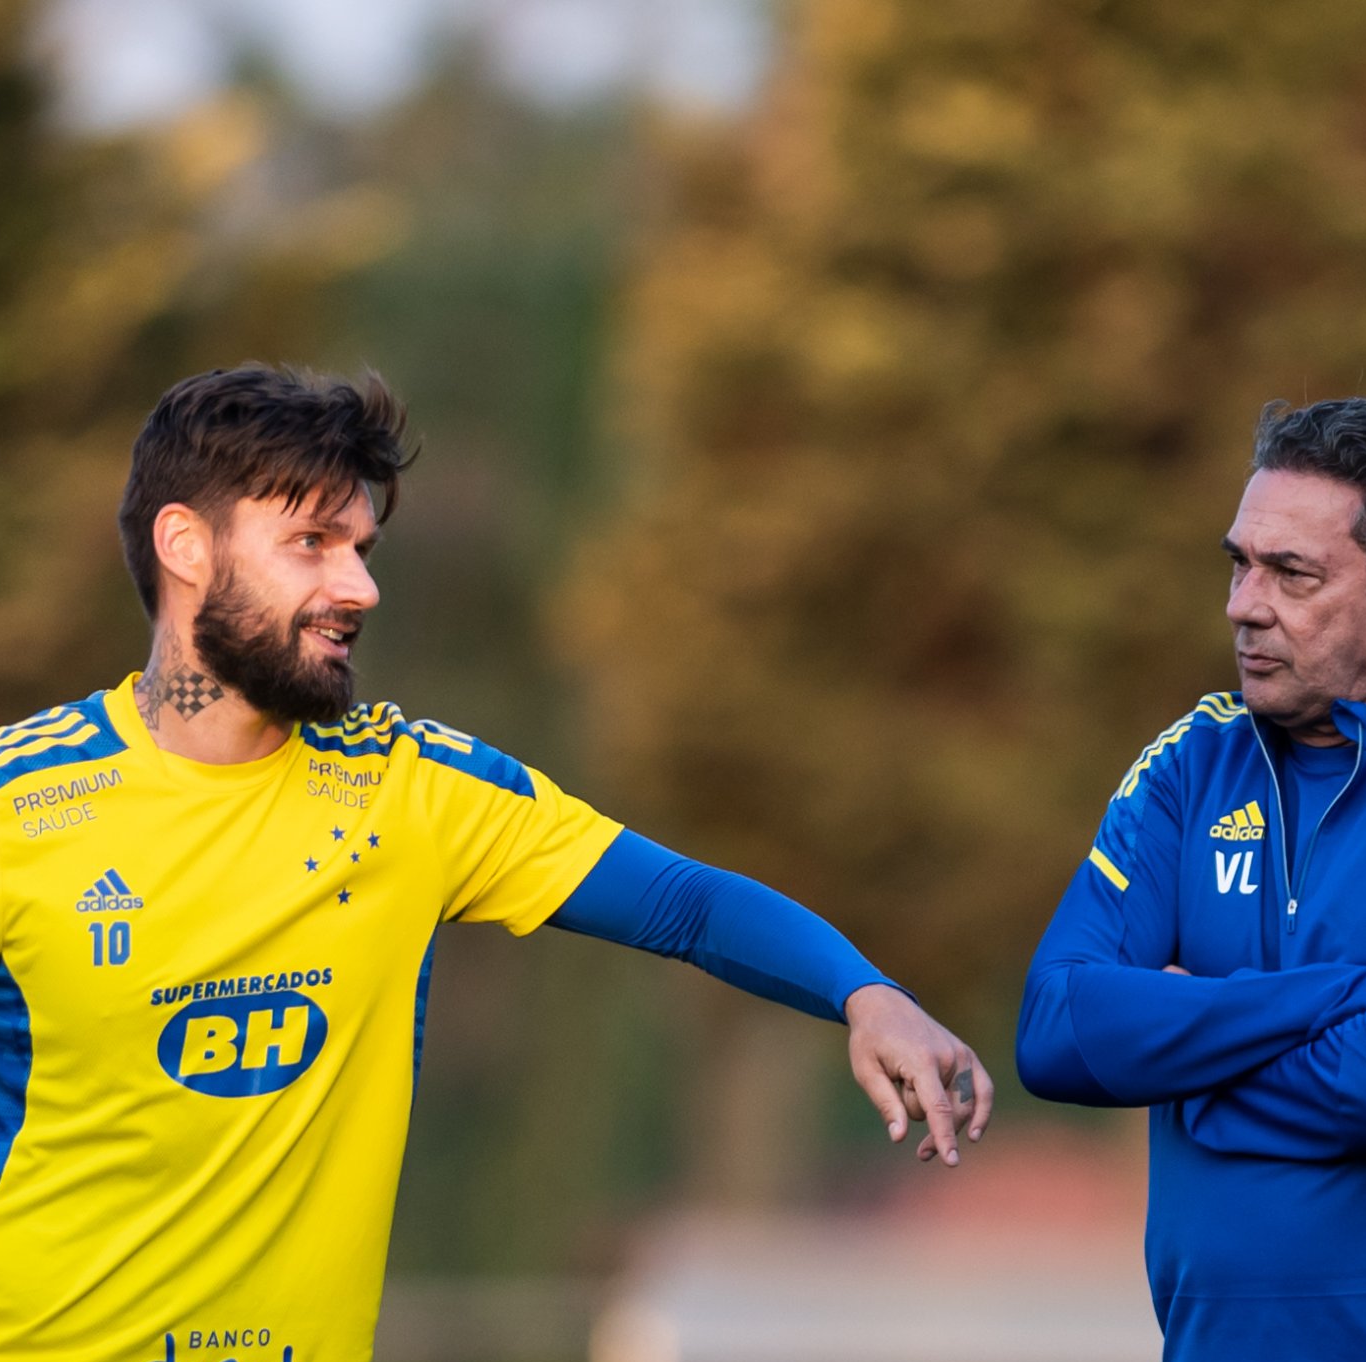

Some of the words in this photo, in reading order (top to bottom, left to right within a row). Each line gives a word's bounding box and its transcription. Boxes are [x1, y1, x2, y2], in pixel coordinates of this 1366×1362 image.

[307, 780, 370, 809] SAÚDE
[23, 801, 98, 838] SAÚDE
[1215, 850, 1259, 894] VL
[76, 895, 144, 912] adidas
[88, 921, 131, 967] 10
[150, 968, 333, 1006] SUPERMERCADOS
[178, 1005, 310, 1078] BH
[189, 1328, 271, 1349] BANCO
